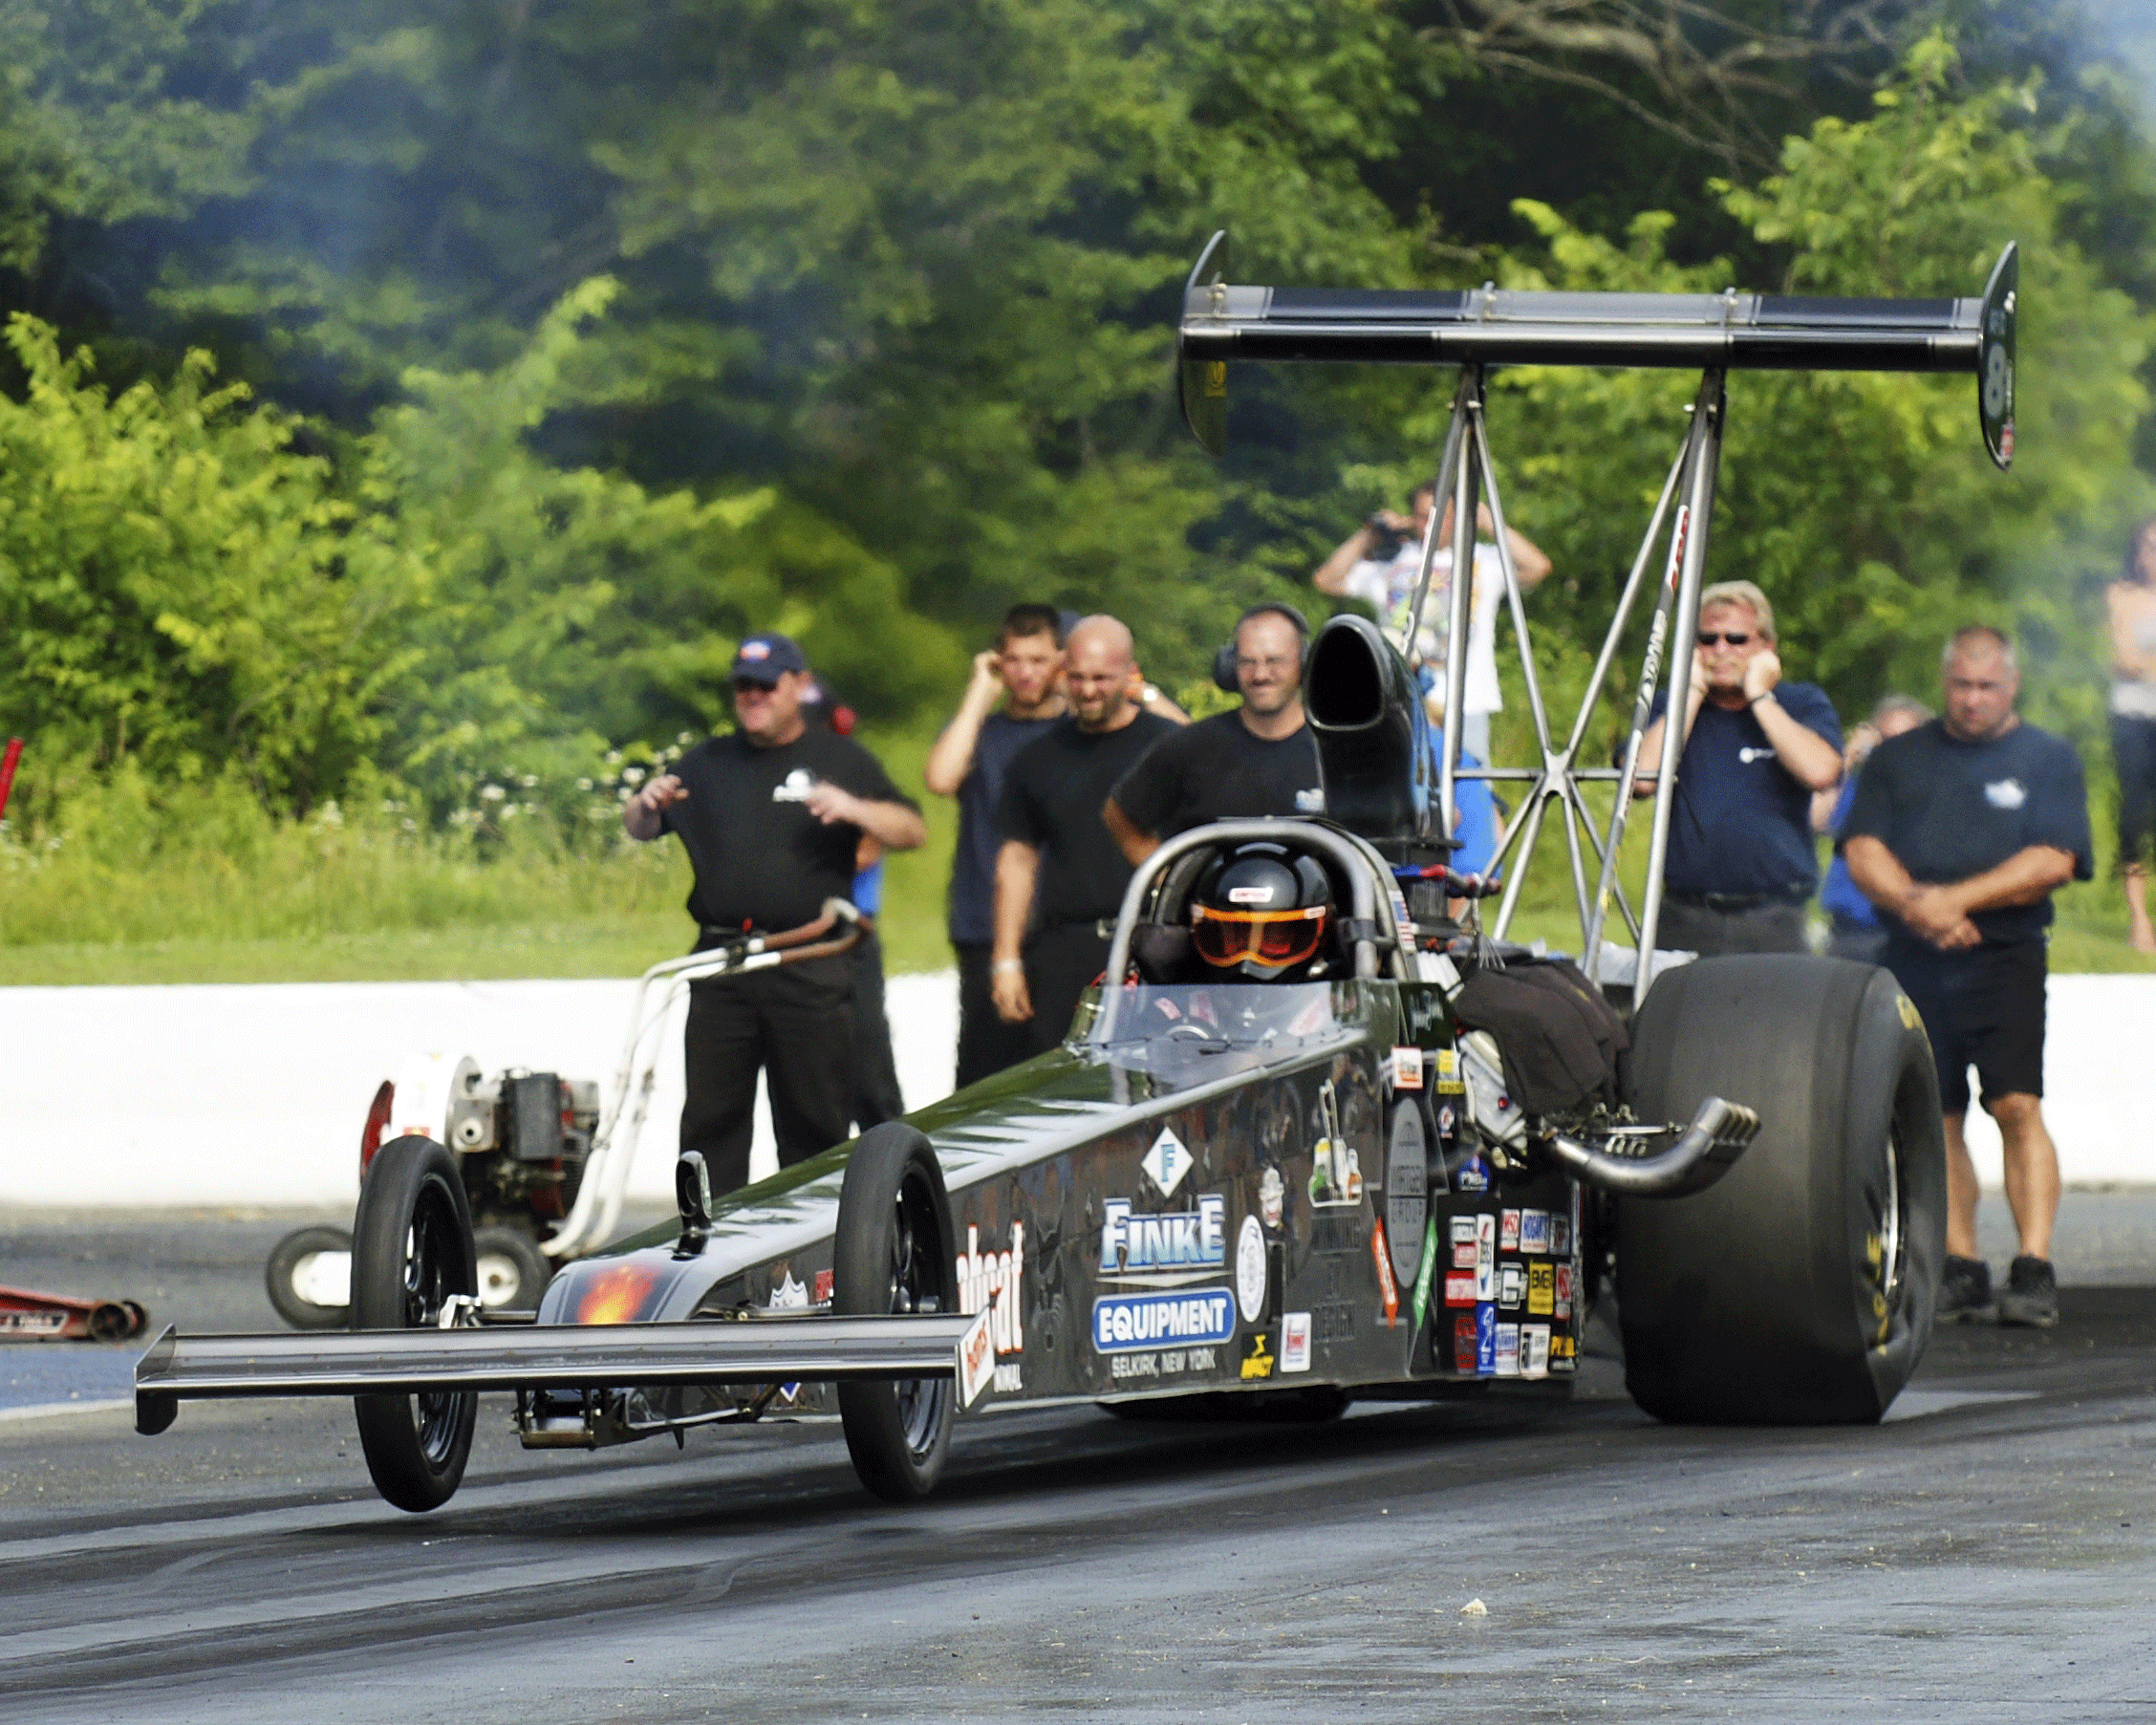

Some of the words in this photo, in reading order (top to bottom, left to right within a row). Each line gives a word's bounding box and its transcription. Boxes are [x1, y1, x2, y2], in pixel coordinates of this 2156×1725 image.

[1160, 1143, 1176, 1182] F
[1101, 1195, 1225, 1273] FINKE
[1100, 1299, 1226, 1343] EQUIPMENT
[1111, 1354, 1159, 1378] SELKIRK,
[1161, 1350, 1188, 1374] NEW
[1189, 1348, 1217, 1371] YORK
